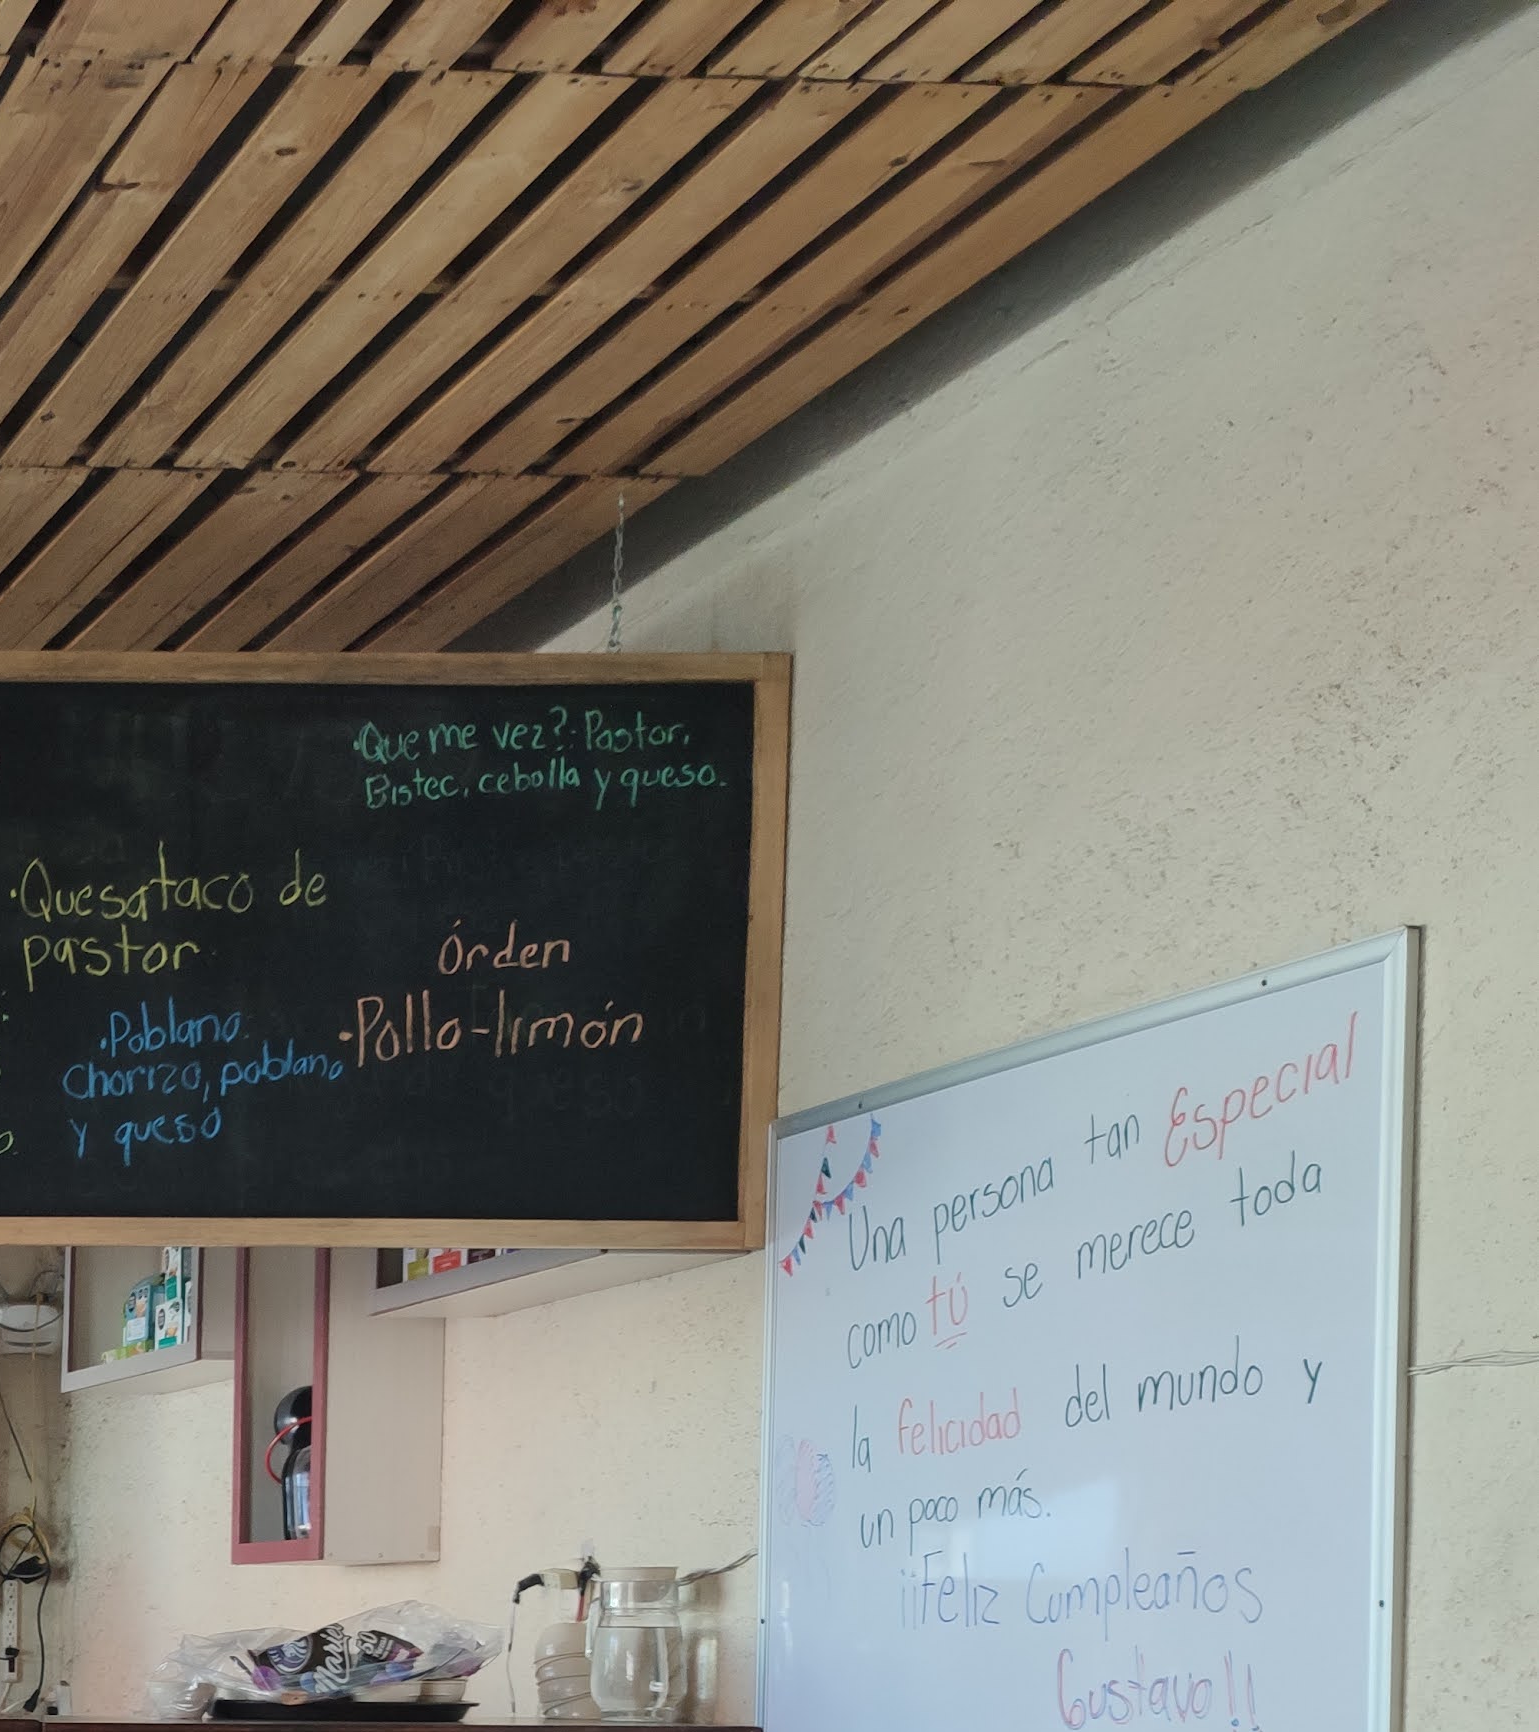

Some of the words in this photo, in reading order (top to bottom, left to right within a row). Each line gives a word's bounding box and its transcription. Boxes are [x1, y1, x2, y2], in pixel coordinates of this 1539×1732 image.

[428, 722, 479, 754] me
[478, 757, 581, 793] cebolla
[594, 768, 611, 811] y
[19, 840, 254, 922] Quesataco
[279, 848, 327, 908] de
[24, 925, 201, 992] pastor
[438, 919, 570, 977] Órden
[70, 1118, 88, 1159] y
[114, 1106, 221, 1167] queso
[848, 1206, 907, 1272] Una
[933, 1156, 1053, 1265] persona
[1085, 1113, 1140, 1164] tan
[1164, 1011, 1359, 1168] Especial
[848, 1311, 917, 1370] como
[925, 1272, 969, 1337] tú
[1003, 1262, 1042, 1307] se
[1077, 1209, 1195, 1280] merece
[1230, 1150, 1322, 1227] toda
[852, 1405, 871, 1472] la
[898, 1387, 1022, 1457] felicidad
[1065, 1364, 1110, 1428] del
[1138, 1336, 1263, 1412] mundo
[1303, 1358, 1323, 1403] y
[860, 1508, 894, 1549] un
[908, 1495, 959, 1555] poco
[1025, 1547, 1263, 1642] Cumpleaños
